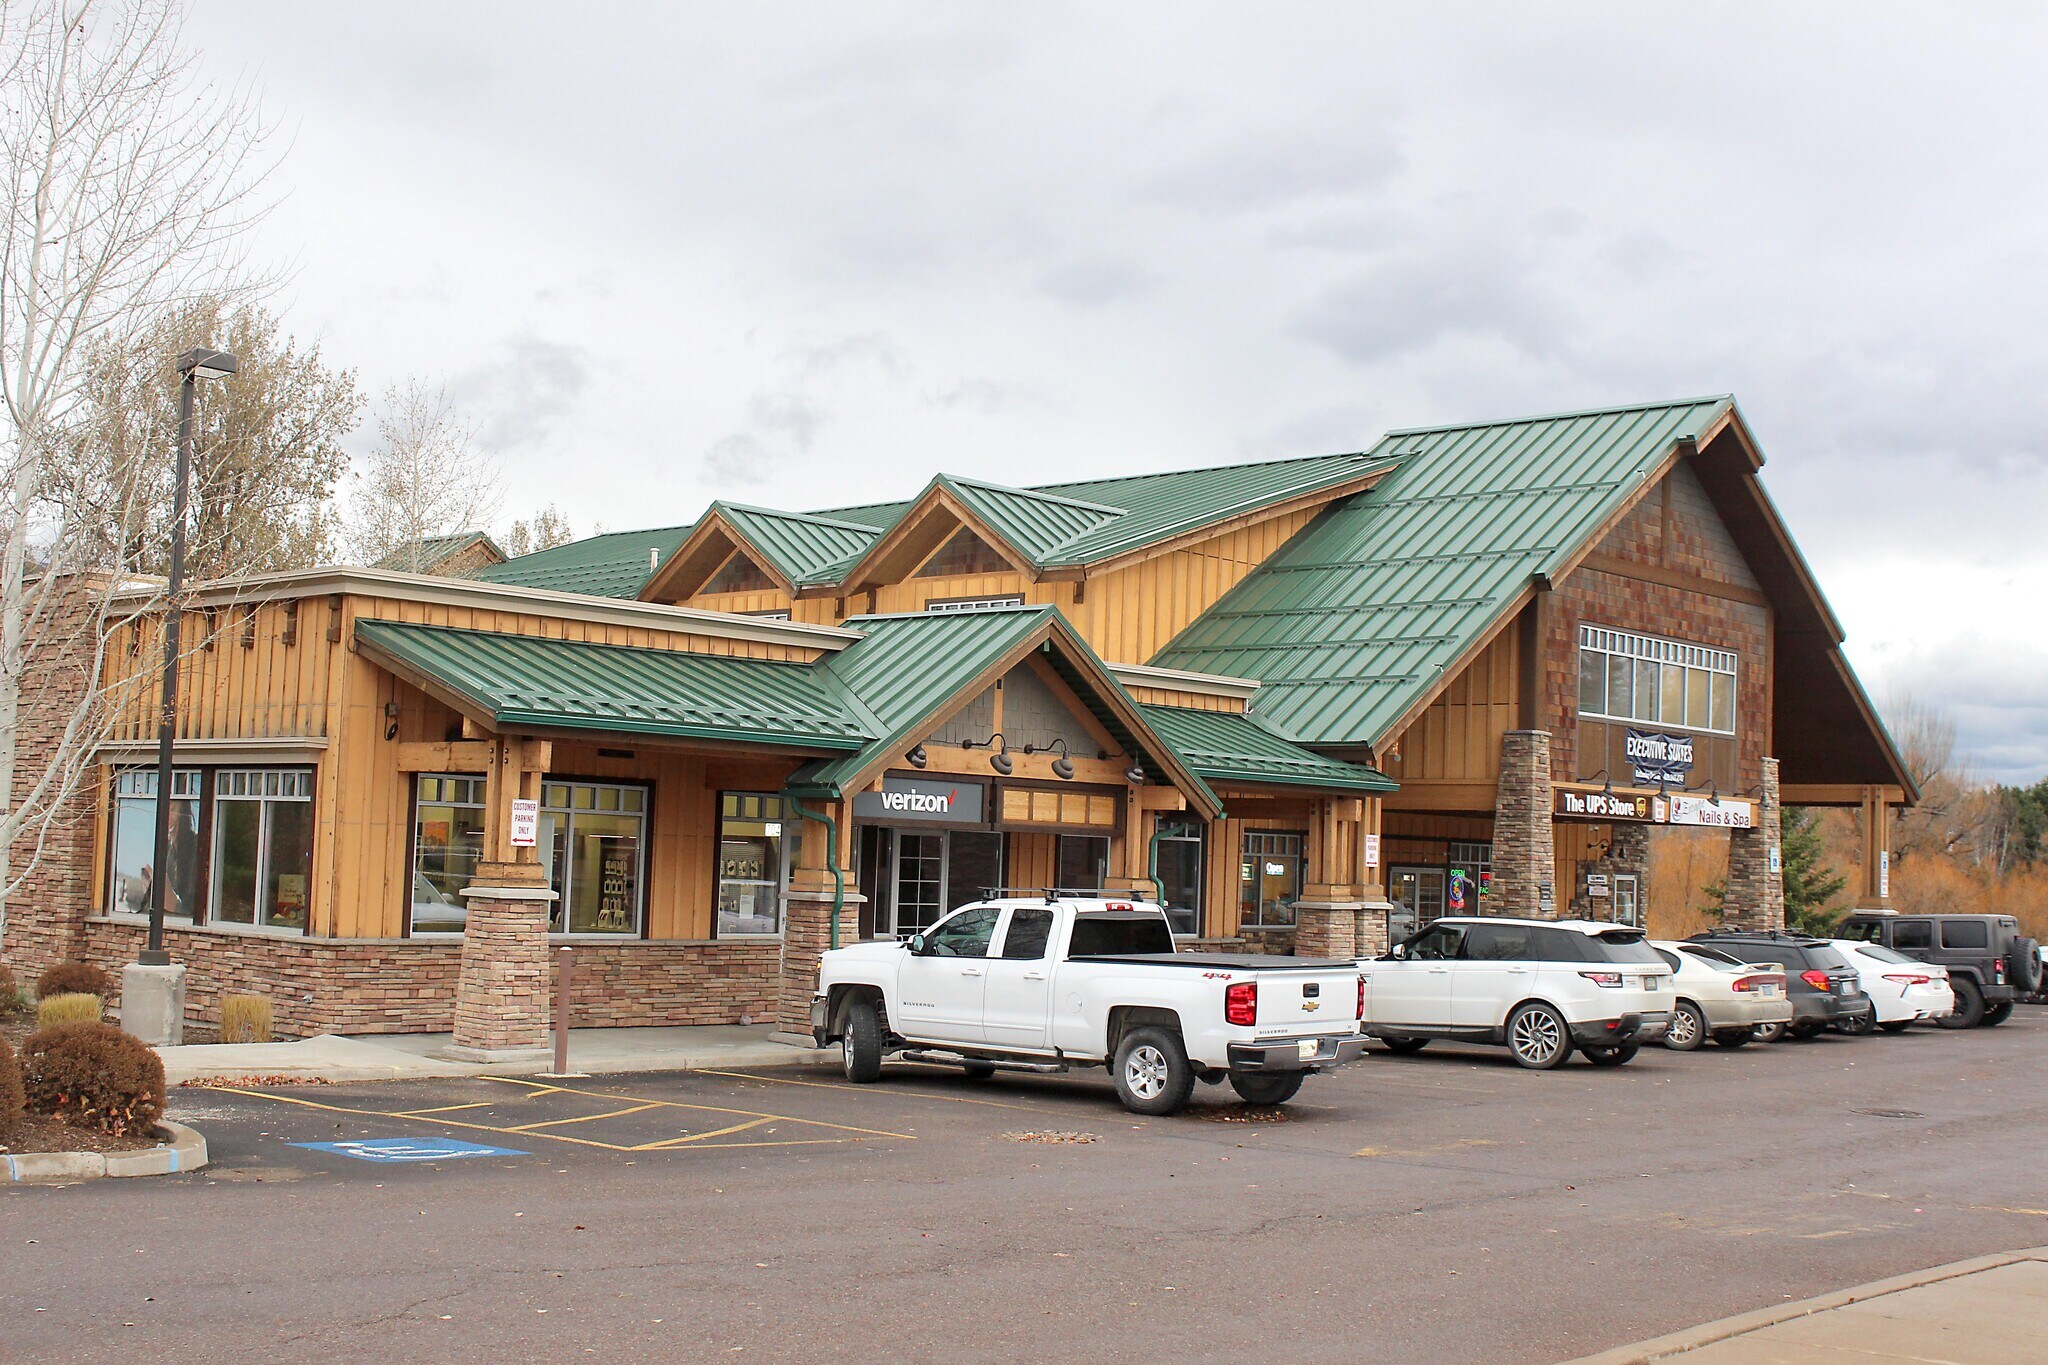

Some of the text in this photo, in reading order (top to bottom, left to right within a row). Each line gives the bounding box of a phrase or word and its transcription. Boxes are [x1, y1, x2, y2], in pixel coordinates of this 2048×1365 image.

[1627, 737, 1693, 763] EXECUTIVE SUITES
[513, 802, 537, 811] CUSTOMER
[881, 788, 948, 812] verizon
[1564, 793, 1585, 812] The
[1586, 795, 1608, 814] UPS
[1609, 797, 1635, 816] Store
[514, 814, 534, 823] PARKING
[1699, 809, 1749, 826] Nails & Spa
[518, 826, 530, 834] ONLY
[1450, 869, 1466, 878] OPEN
